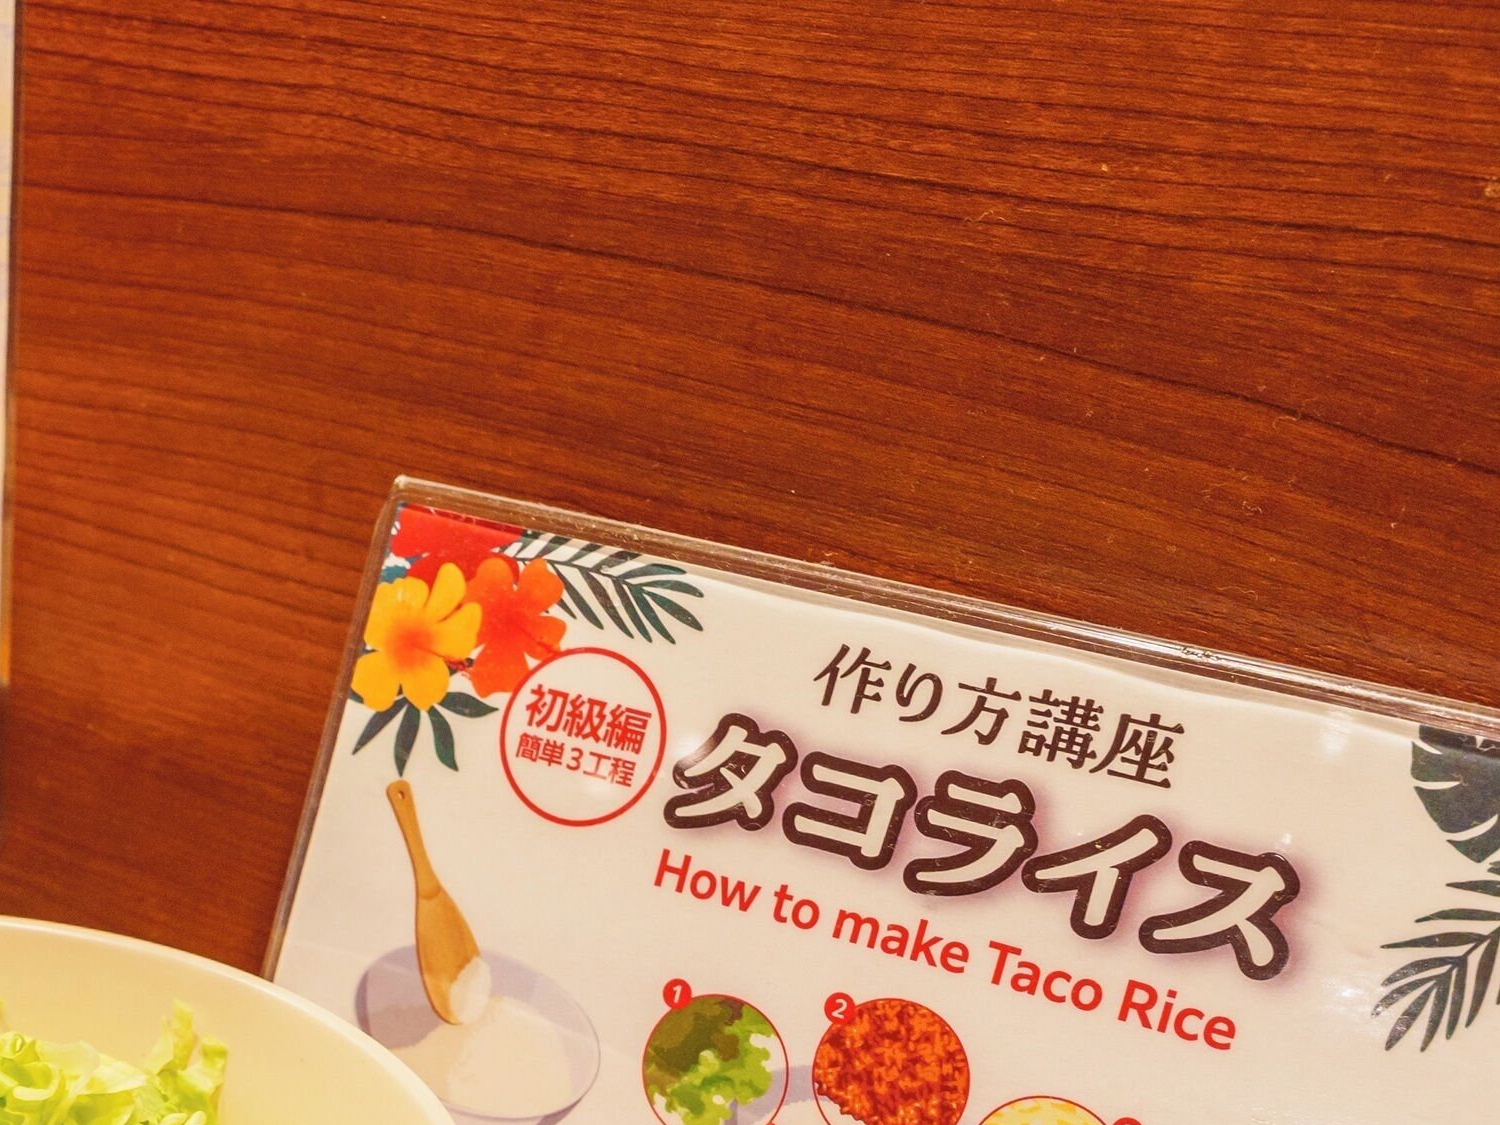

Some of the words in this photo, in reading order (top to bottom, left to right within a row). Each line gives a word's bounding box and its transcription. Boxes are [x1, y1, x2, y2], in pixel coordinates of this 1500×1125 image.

[525, 684, 652, 755] 初級編
[813, 643, 1185, 788] 作り方講座
[662, 712, 1301, 981] タコライス
[653, 849, 761, 911] How
[772, 884, 820, 931] to
[831, 908, 970, 974] make
[987, 941, 1104, 1011] Taco
[1117, 980, 1237, 1051] Rice
